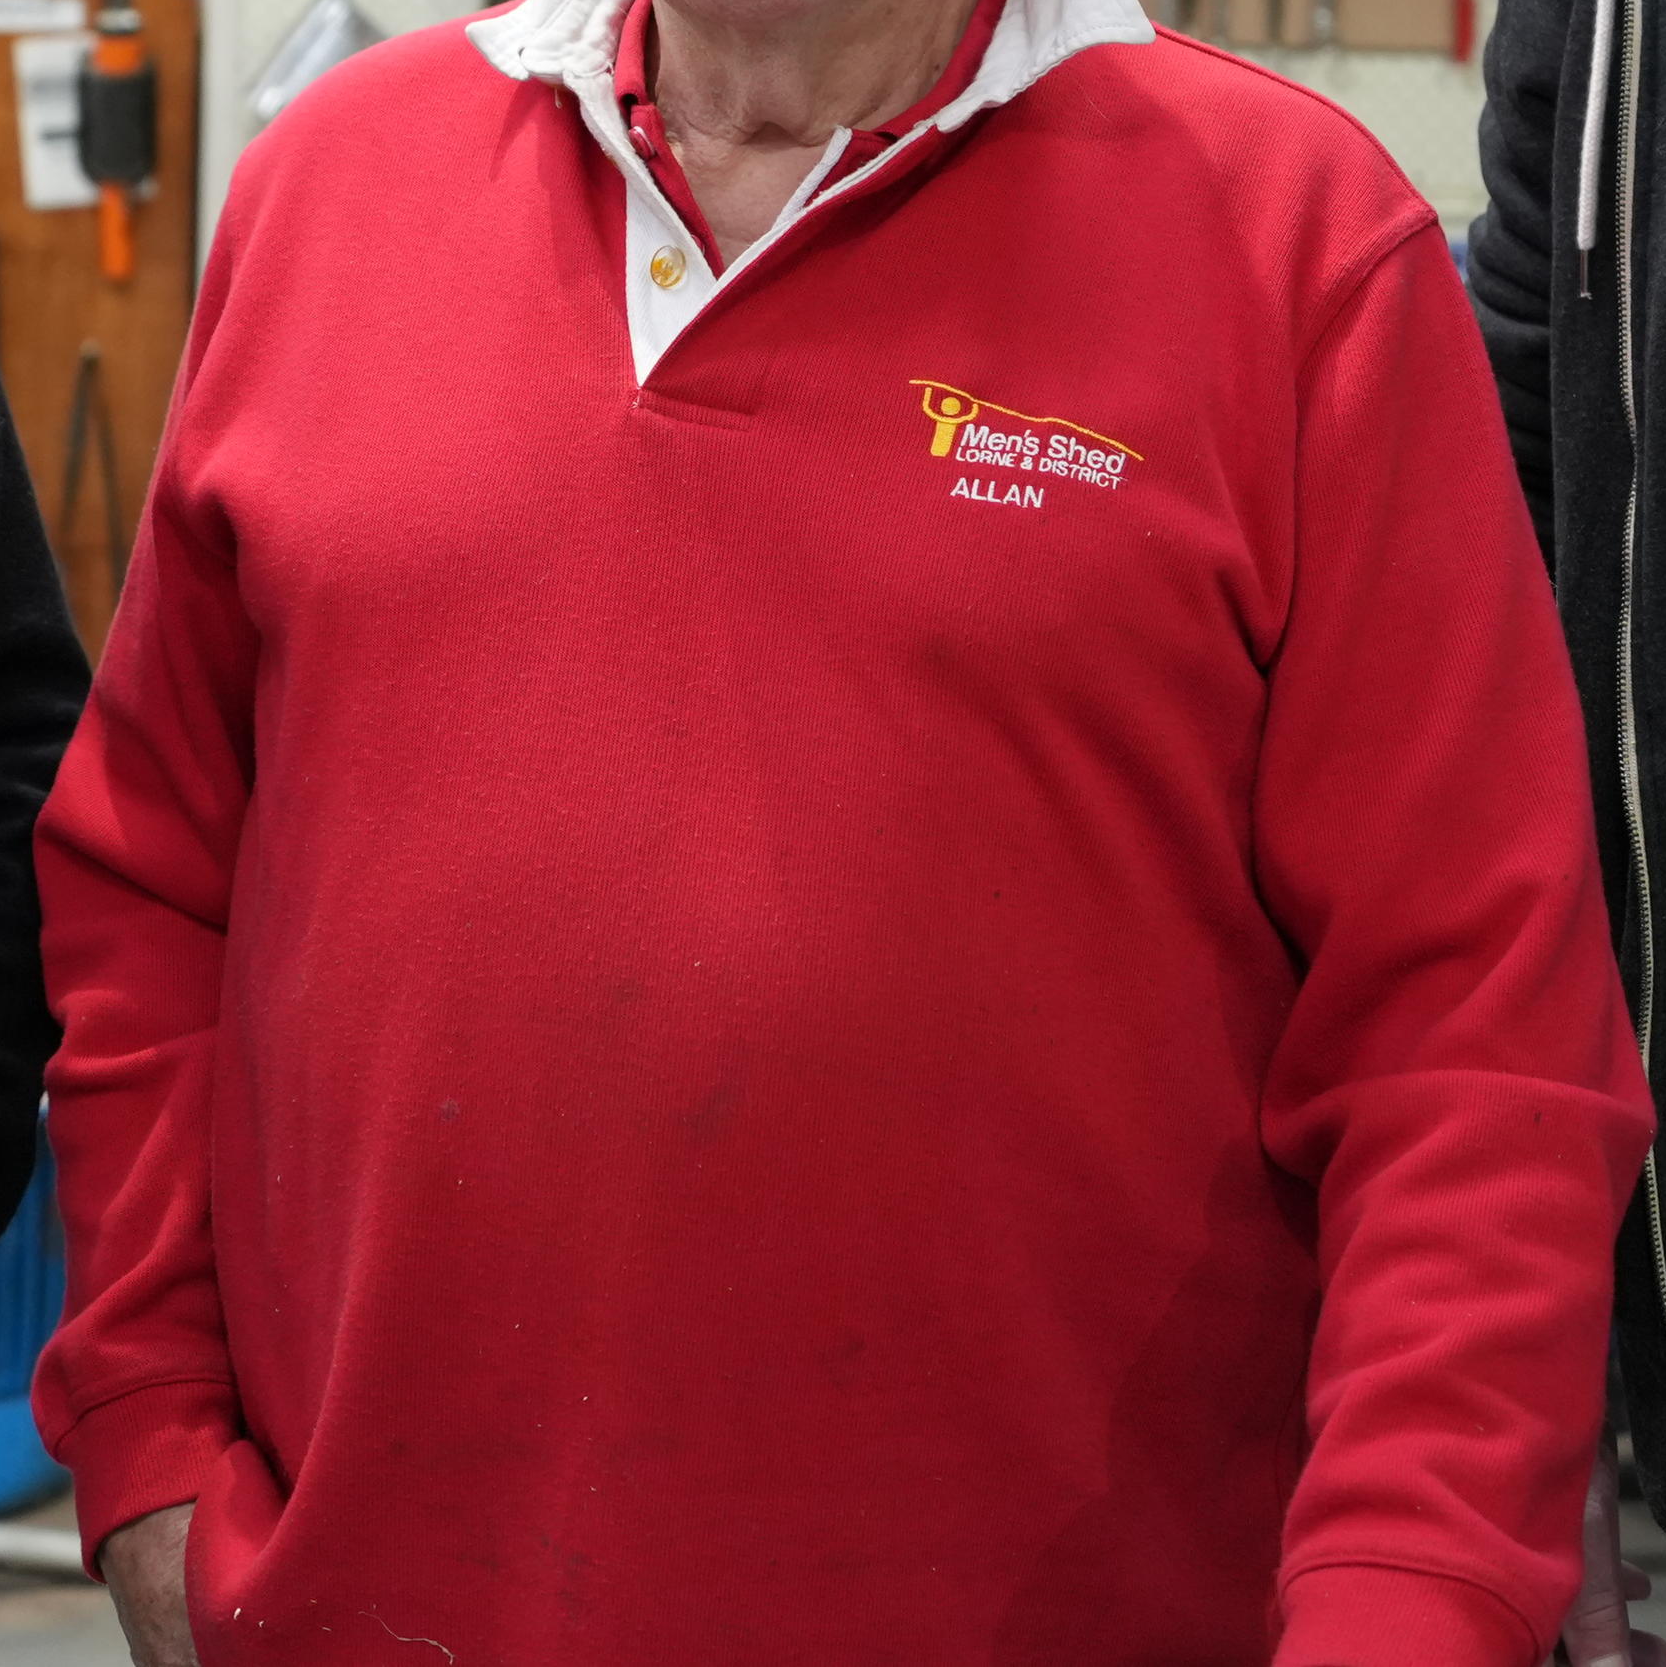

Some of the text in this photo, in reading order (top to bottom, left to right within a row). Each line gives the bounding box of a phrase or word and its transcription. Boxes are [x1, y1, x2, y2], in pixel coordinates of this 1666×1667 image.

[955, 446, 1122, 490] LORNE & DISTRICT
[960, 423, 1126, 474] Men's Shed
[950, 477, 1045, 509] ALLAN
